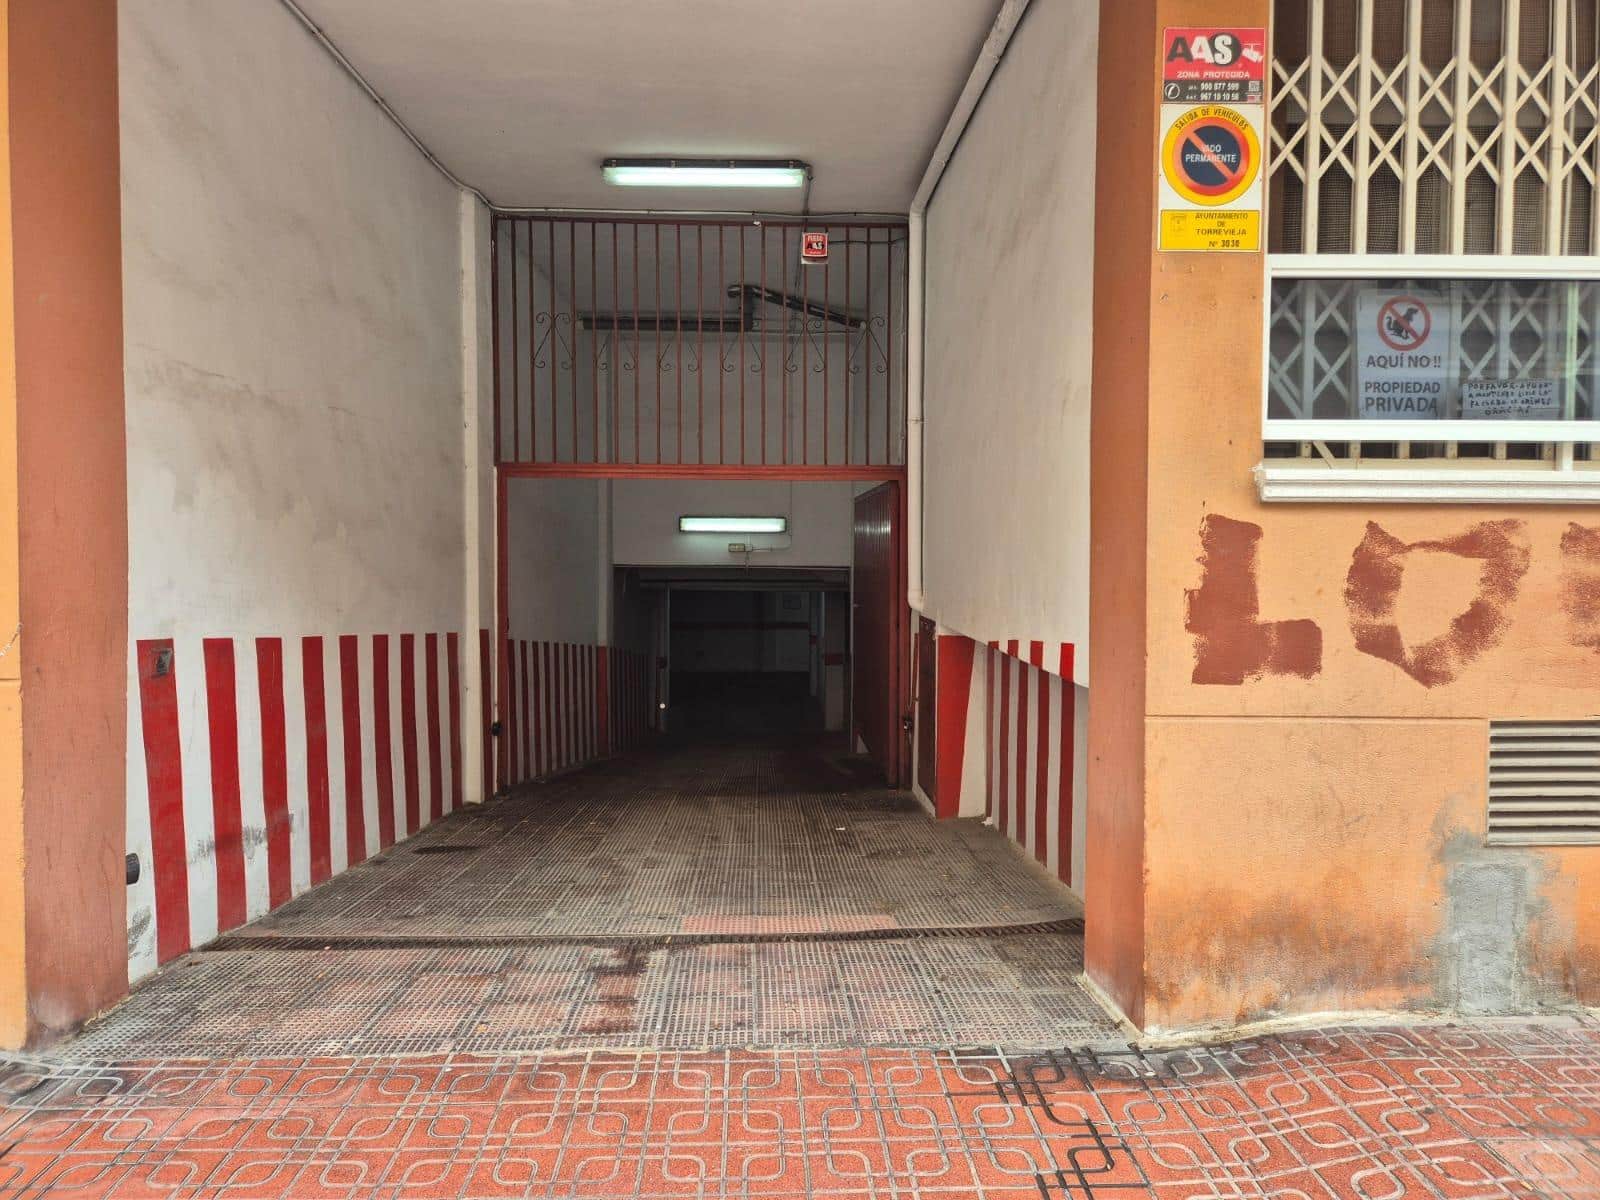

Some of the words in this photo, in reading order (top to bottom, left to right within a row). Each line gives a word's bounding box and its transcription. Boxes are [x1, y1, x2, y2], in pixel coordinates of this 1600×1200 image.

[1167, 35, 1232, 65] AAS
[1175, 111, 1198, 130] SALIDA
[1201, 108, 1210, 116] DE
[1195, 212, 1248, 220] AYUNTAMIENTO
[1195, 228, 1247, 236] TORREVIEJA
[1366, 352, 1405, 369] AQUÍ
[1407, 355, 1432, 369] NO
[1364, 381, 1441, 394] PROPIEDAD
[1365, 396, 1440, 414] PRIVADA
